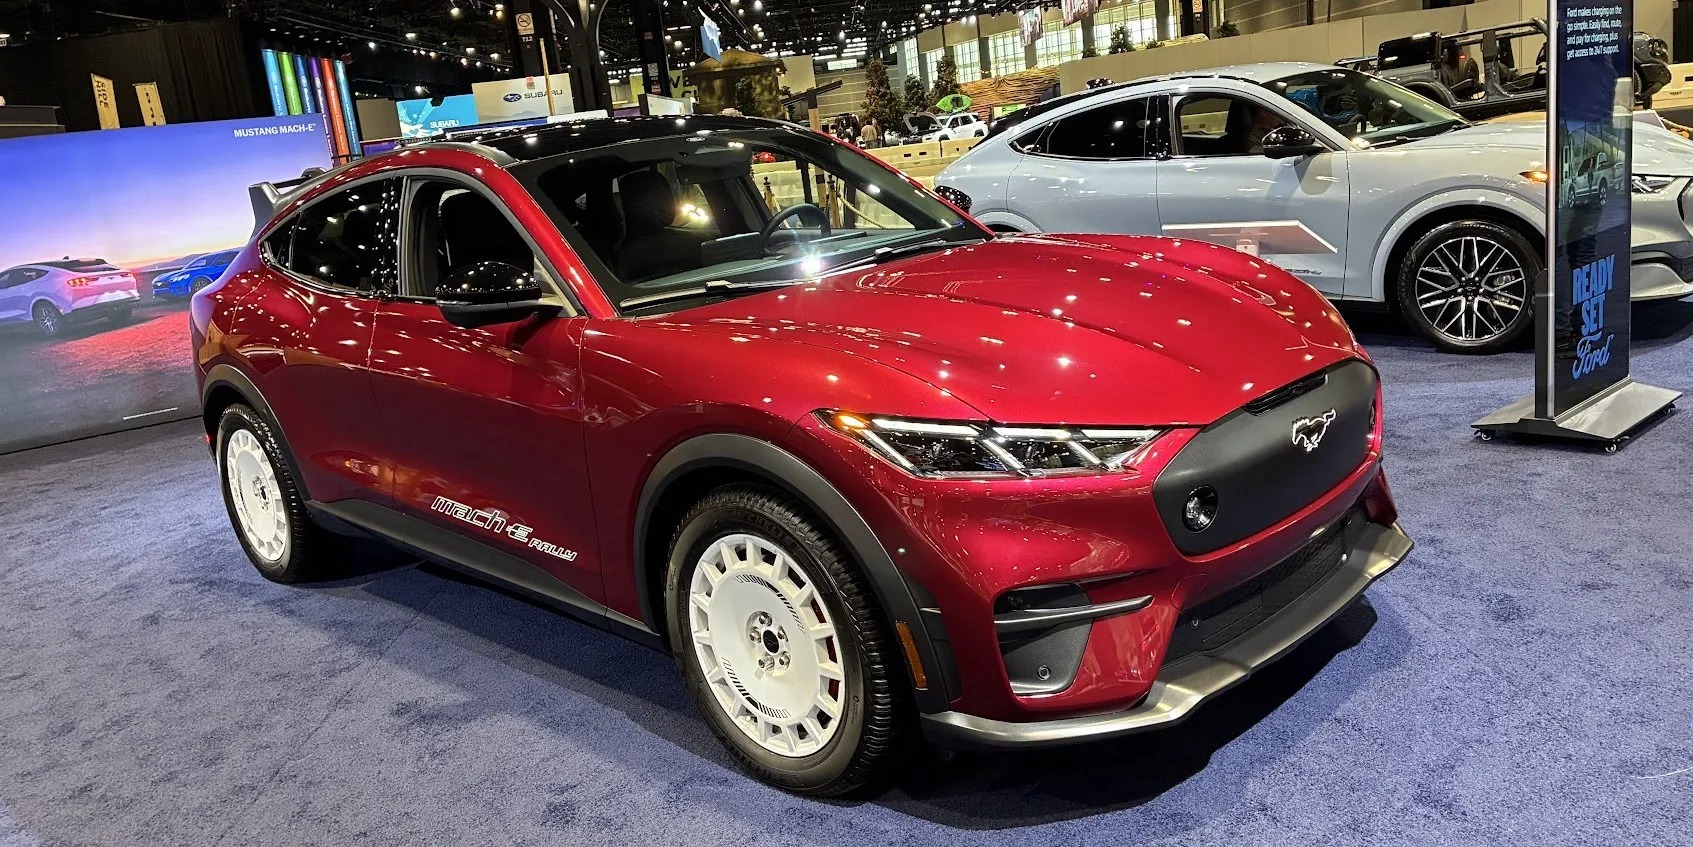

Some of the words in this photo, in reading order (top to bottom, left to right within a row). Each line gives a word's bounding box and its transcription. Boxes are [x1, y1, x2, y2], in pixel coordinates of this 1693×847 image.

[1567, 7, 1577, 17] Ford
[1578, 7, 1591, 17] makes
[1592, 6, 1609, 17] charging
[1567, 23, 1573, 33] go
[1574, 20, 1589, 32] simple.
[1589, 19, 1600, 30] Easily
[1601, 19, 1610, 29] find,
[1611, 19, 1622, 29] route,
[1567, 35, 1575, 45] and
[1576, 36, 1584, 45] pay
[1591, 32, 1609, 43] charging,
[1610, 31, 1618, 42] plus
[1575, 49, 1588, 57] access
[1589, 47, 1594, 55] to
[1594, 45, 1603, 55] 24/7
[1603, 44, 1619, 55] support.
[524, 89, 563, 99] SUBARU
[430, 119, 460, 129] SUBARU
[234, 126, 279, 138] MUSTANG
[1573, 255, 1615, 306] READY
[1582, 293, 1606, 336] SET
[1572, 331, 1614, 379] Ford
[528, 538, 577, 562] RALLY
